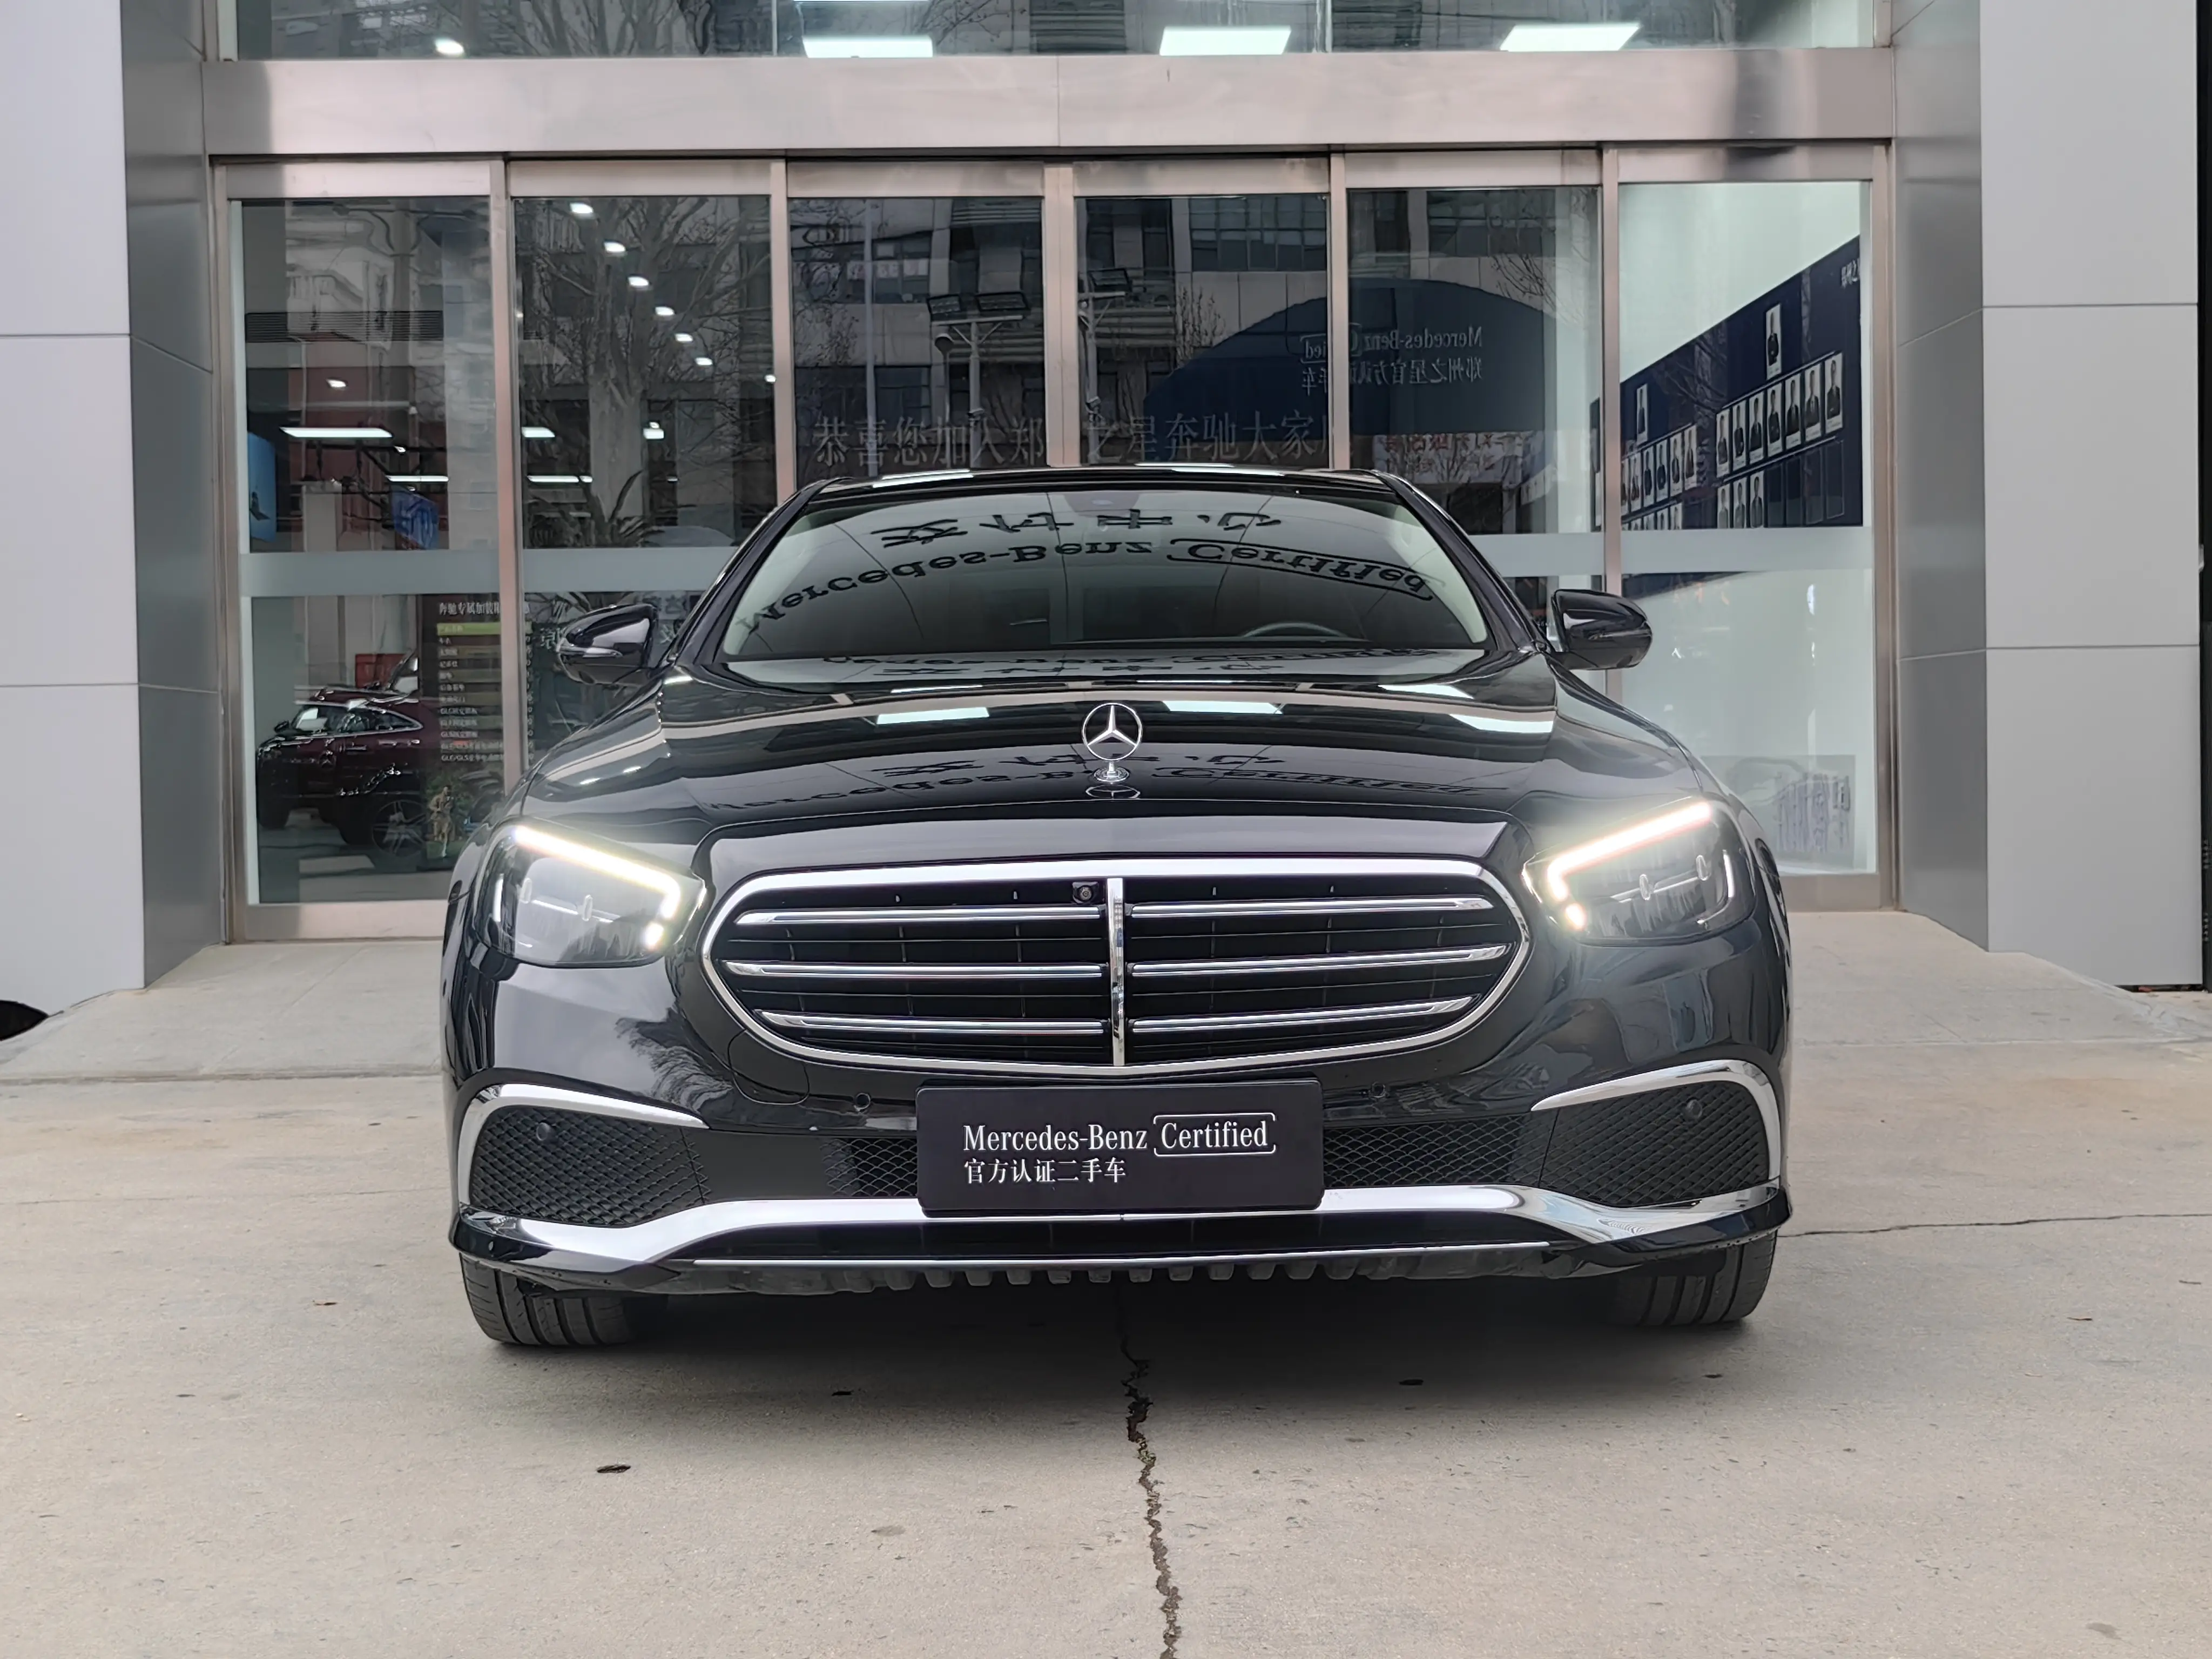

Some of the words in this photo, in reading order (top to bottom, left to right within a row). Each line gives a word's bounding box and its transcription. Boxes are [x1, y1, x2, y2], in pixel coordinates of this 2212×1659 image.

[963, 1123, 1148, 1151] Mercedes-Benz
[1161, 1121, 1268, 1149] Certified
[964, 1158, 1126, 1183] 官方认证二手车
